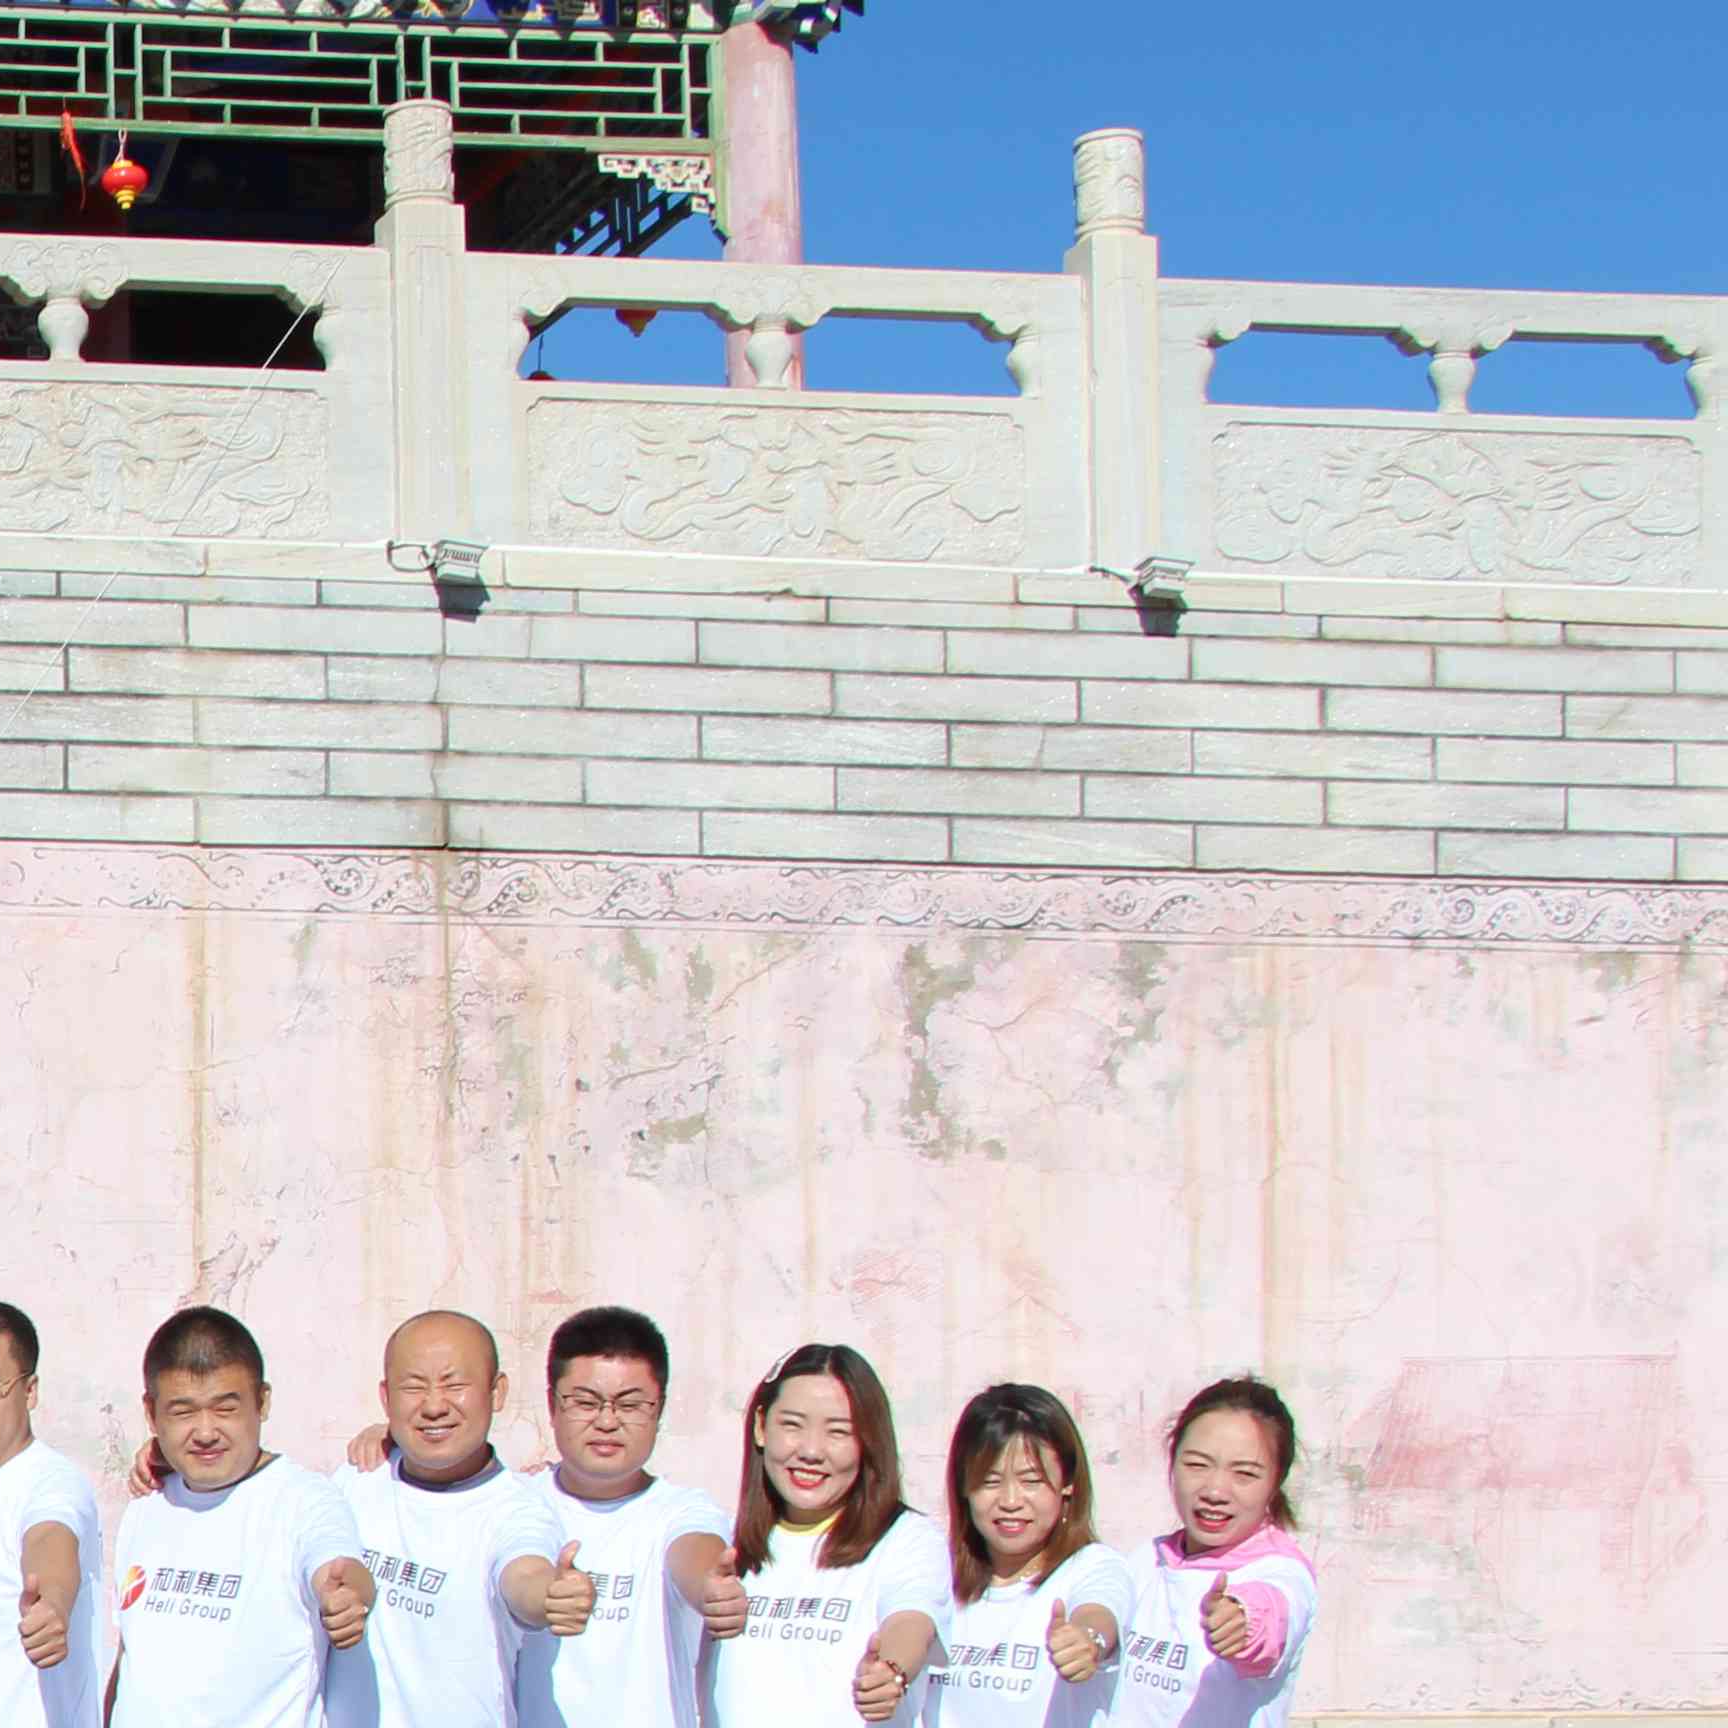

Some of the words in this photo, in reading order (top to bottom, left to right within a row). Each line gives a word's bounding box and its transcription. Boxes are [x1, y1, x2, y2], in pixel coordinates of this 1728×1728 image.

[150, 1567, 242, 1599] 和利集团
[179, 1598, 232, 1622] Group
[386, 1588, 435, 1620] Group
[780, 1623, 843, 1645] Group
[968, 1671, 1033, 1695] Group
[1134, 1665, 1181, 1695] Group
